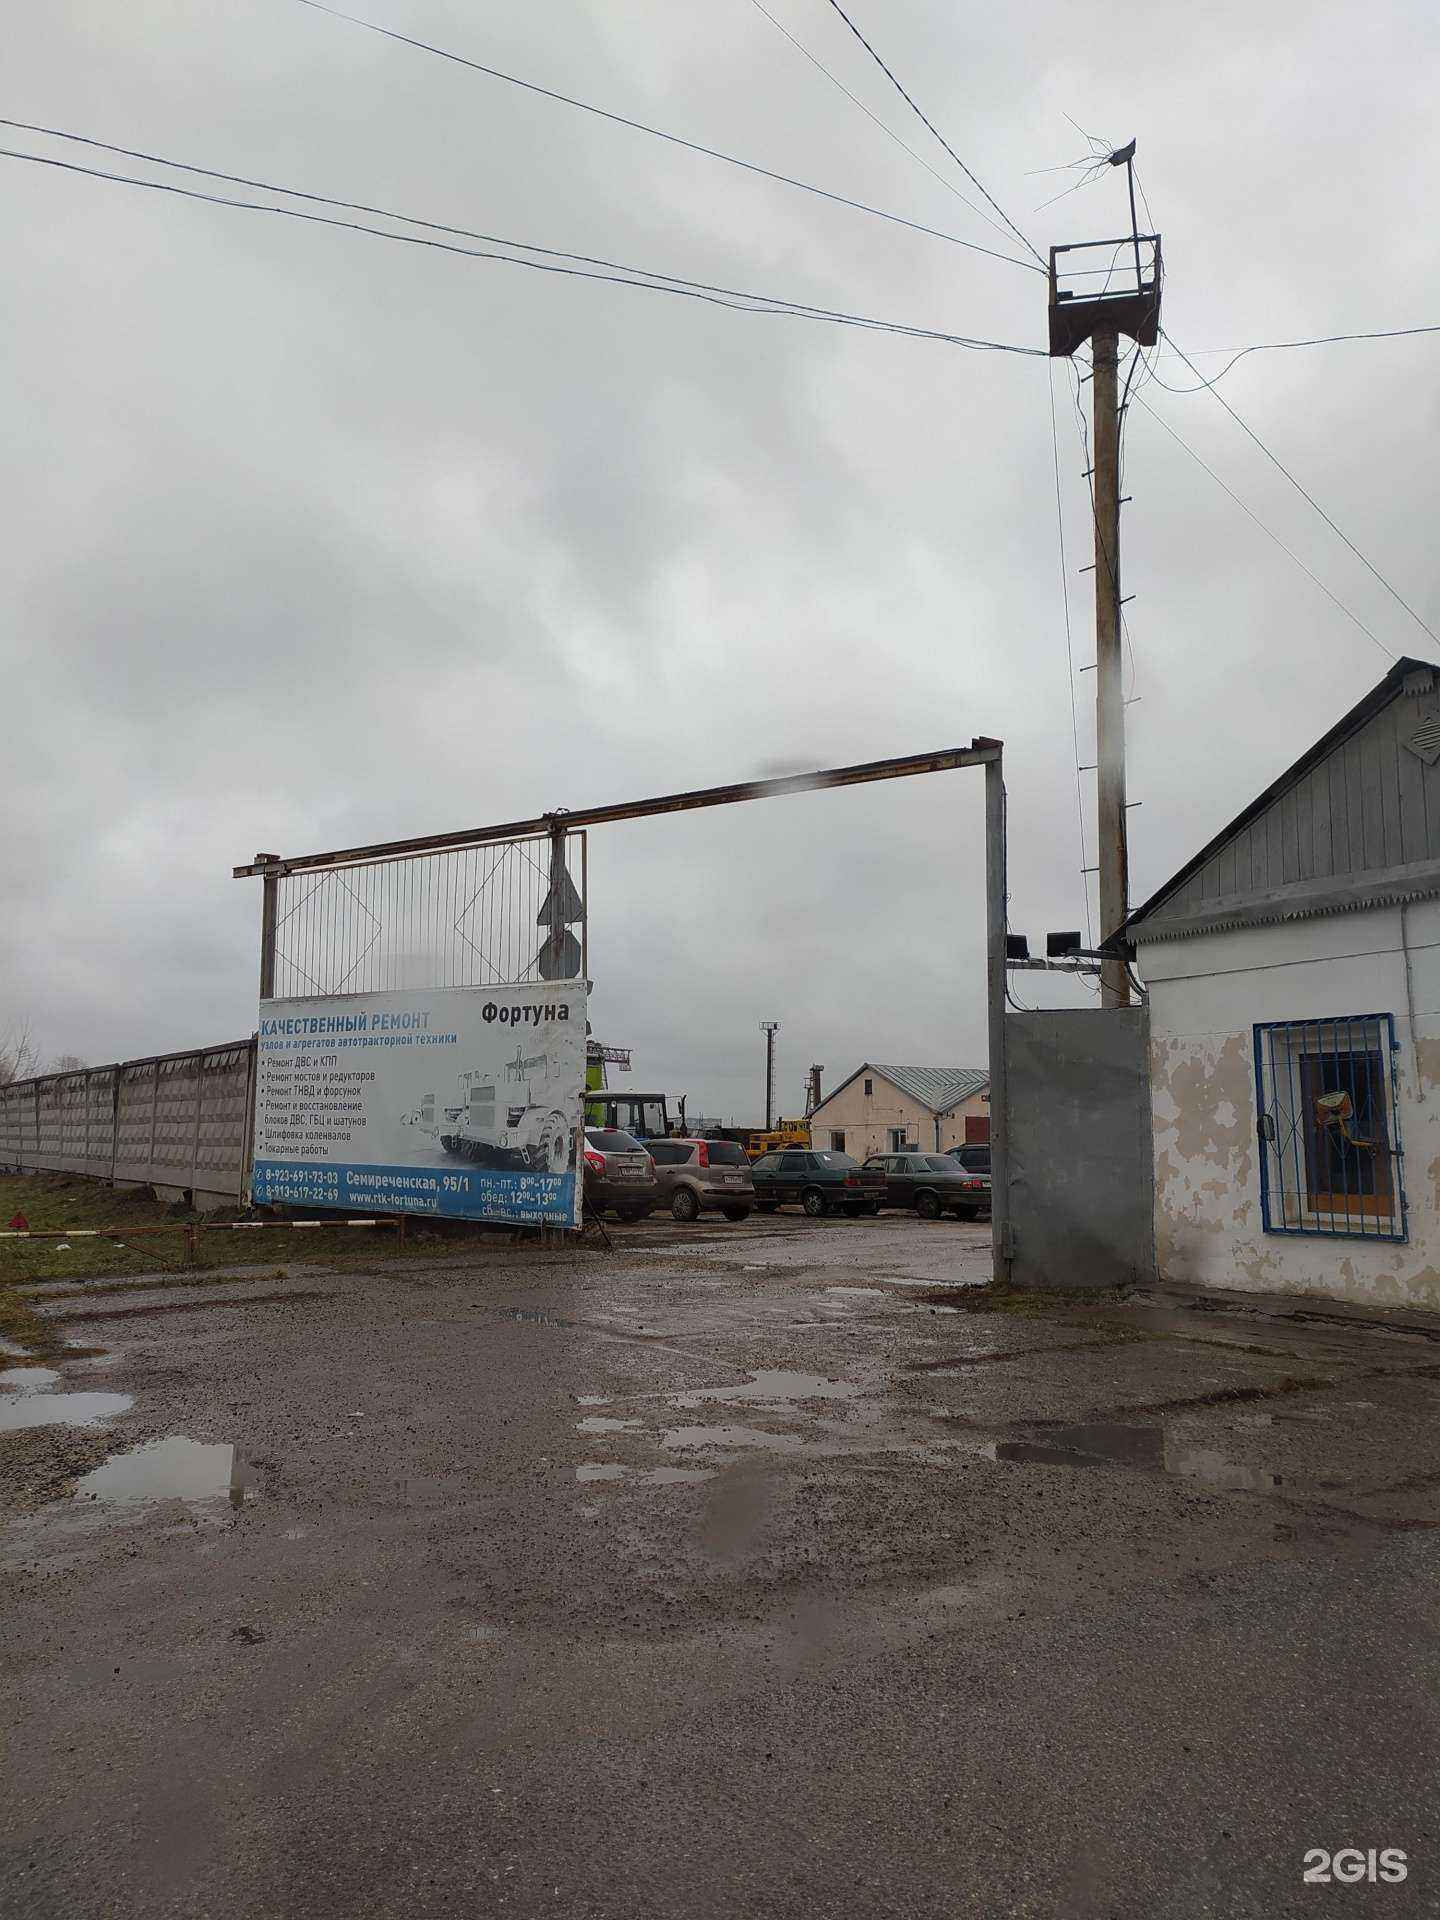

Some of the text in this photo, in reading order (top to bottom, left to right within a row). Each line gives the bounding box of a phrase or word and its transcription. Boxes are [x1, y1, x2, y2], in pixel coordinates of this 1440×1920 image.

[482, 1001, 569, 1027] Фортуна
[261, 1011, 431, 1036] КАЧЕСТВЕННЫЙ РЕМОНТ
[261, 1039, 284, 1051] узлов
[292, 1038, 336, 1051] агрегатов
[338, 1033, 413, 1049] автотракторной
[415, 1032, 457, 1046] техники
[267, 1057, 293, 1068] Ремонт
[295, 1056, 312, 1069] ДВС
[320, 1055, 338, 1067] КПП
[266, 1071, 293, 1082] Ремонт
[295, 1073, 321, 1082] мостов
[329, 1071, 376, 1084] редукторов
[266, 1085, 292, 1096] Ремонт
[294, 1085, 315, 1097] ТНВД
[323, 1086, 361, 1098] форсунок
[265, 1099, 291, 1110] Ремонт
[300, 1101, 363, 1111] восстановление
[264, 1113, 288, 1125] блоков
[310, 1114, 325, 1126] ГБЦ
[334, 1117, 367, 1128] шатунов
[265, 1127, 351, 1141] Шлифовка коленвалов
[265, 1142, 329, 1156] Токарные работы
[265, 1168, 338, 1184] 8-923-691-73-03
[346, 1170, 470, 1192] Семиреченская, 95/1
[265, 1184, 339, 1201] 8-913-617-22-69
[349, 1192, 438, 1208] www.rtk-fortuna.ru
[481, 1190, 508, 1205] обед:
